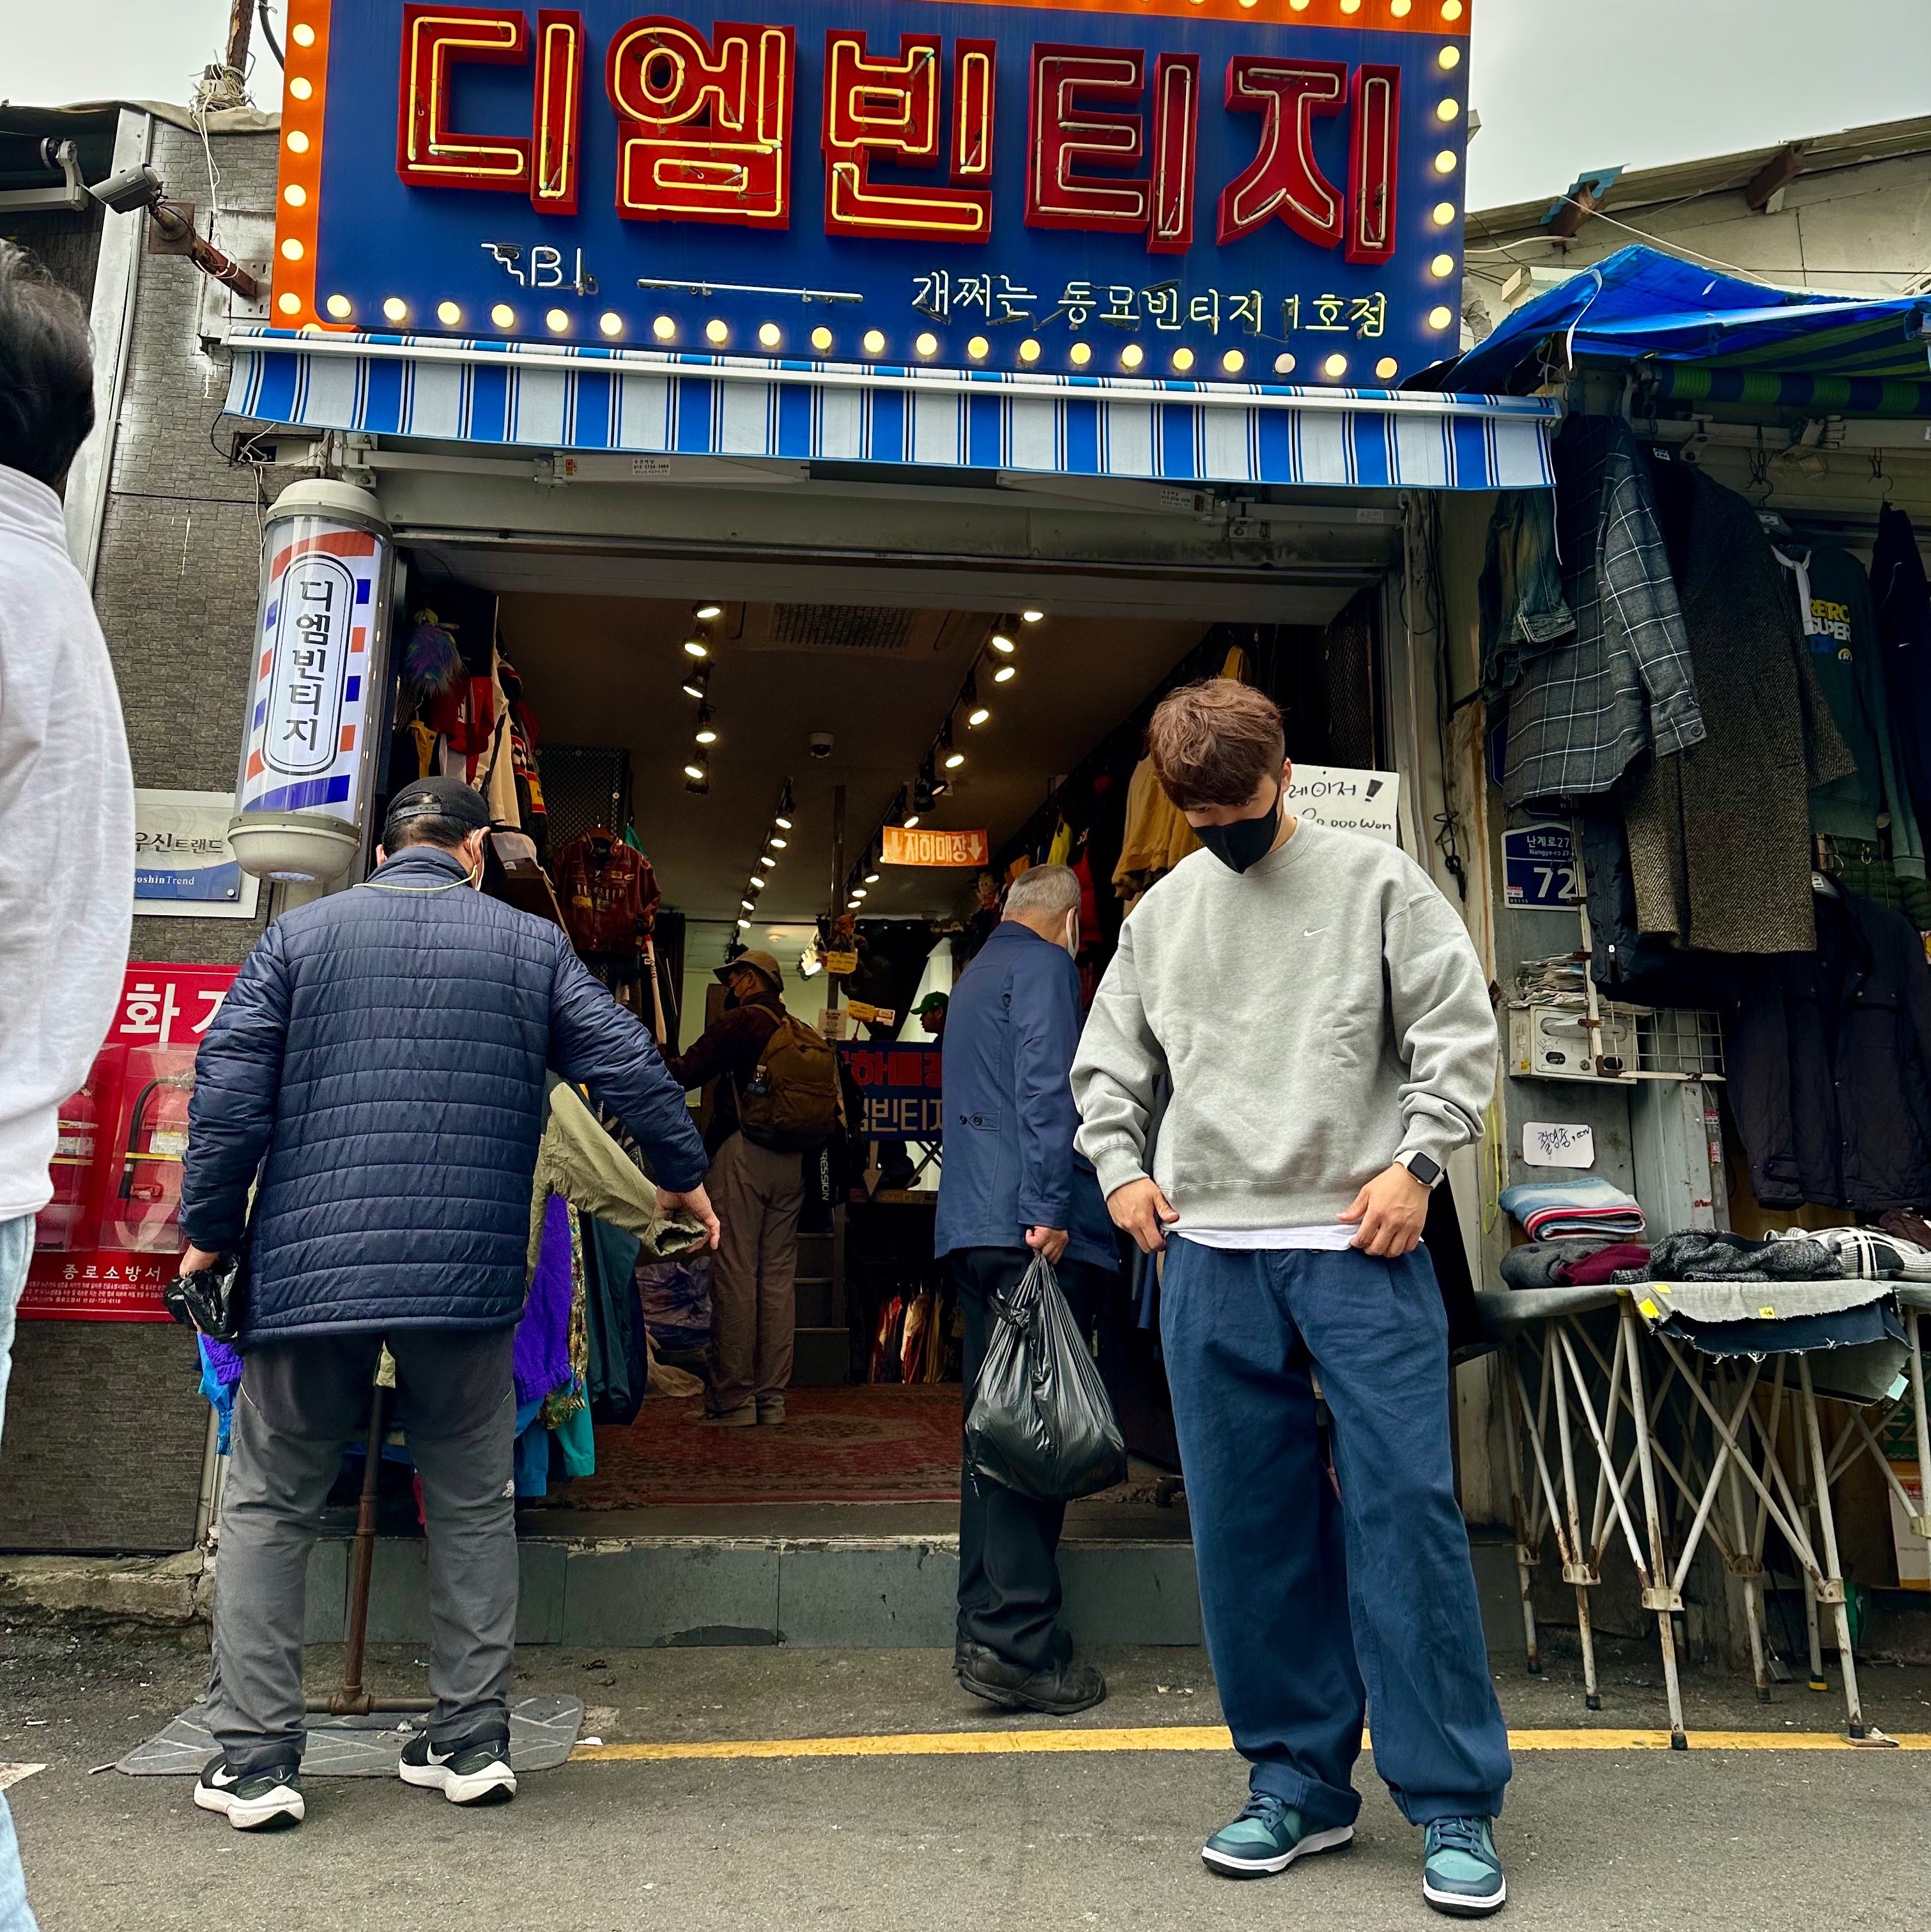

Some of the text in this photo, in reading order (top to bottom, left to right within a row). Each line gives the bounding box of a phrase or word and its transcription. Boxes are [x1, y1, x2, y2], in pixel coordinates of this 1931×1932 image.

[396, 3, 1401, 263] 디엠빈티지
[1284, 292, 1385, 337] 1호점
[282, 579, 333, 751] 디엠빈티지
[904, 832, 967, 863] 지하매장
[1534, 867, 1578, 899] 72
[62, 1264, 161, 1282] 종로소방서
